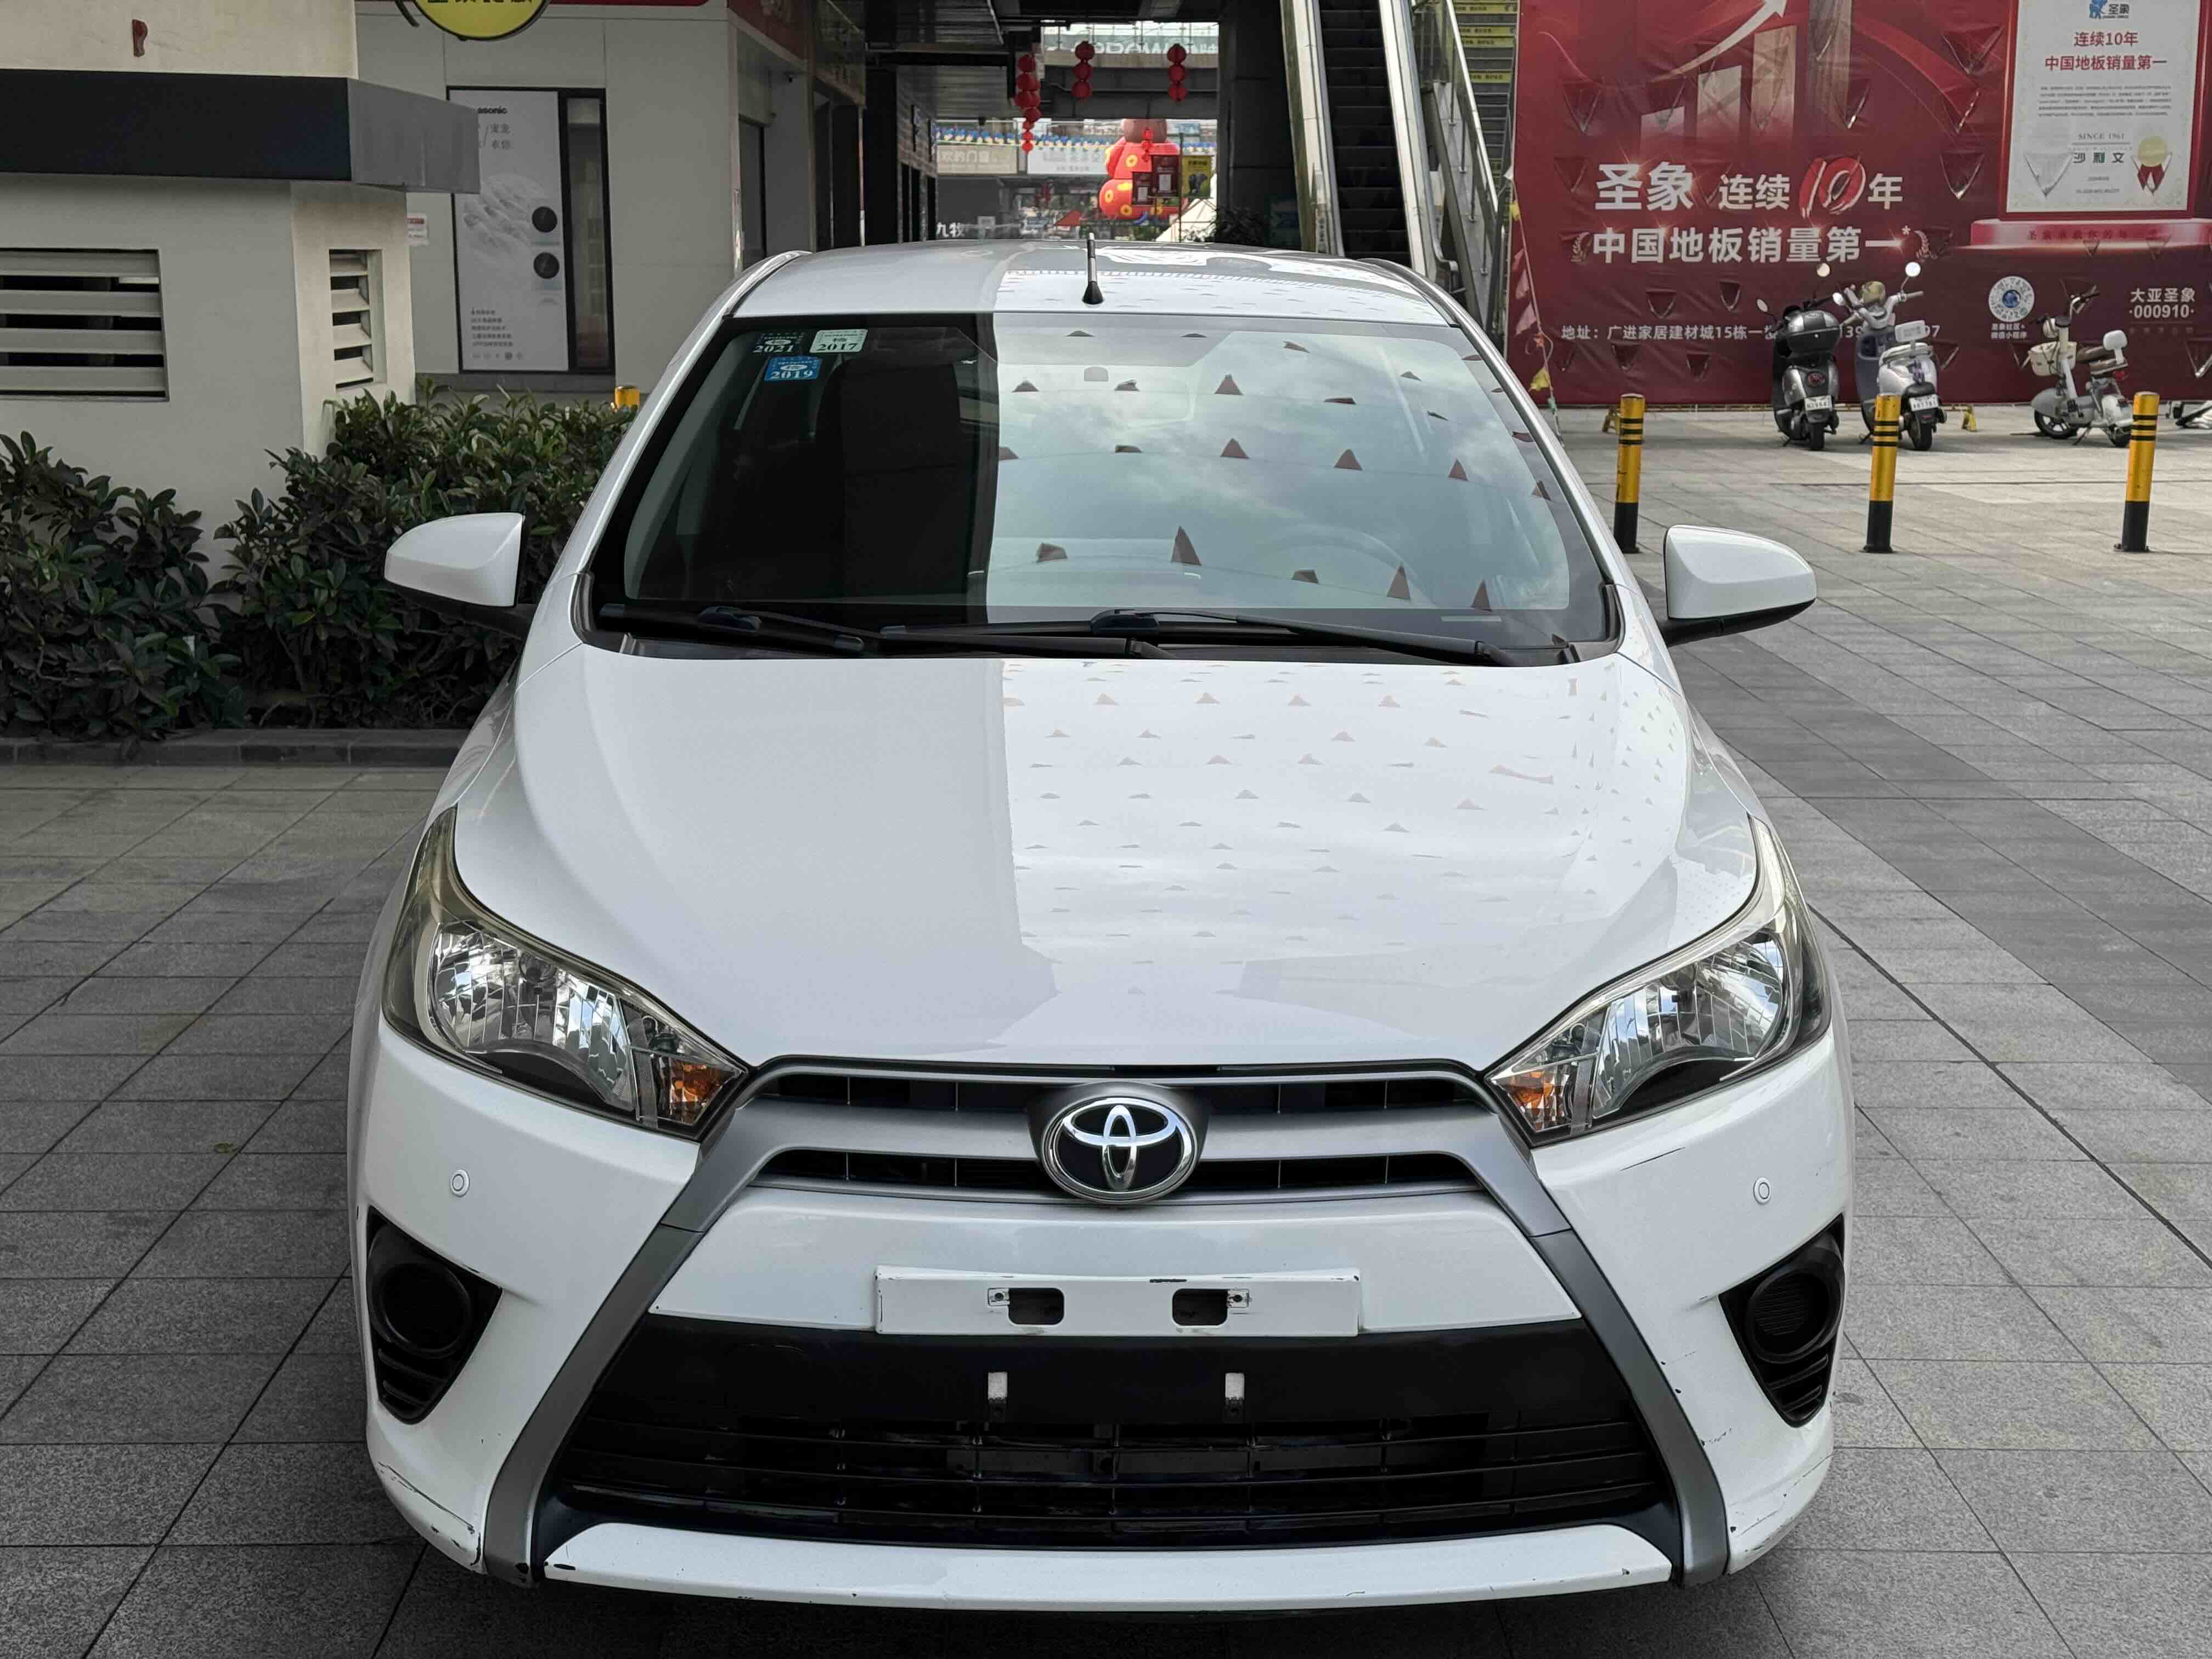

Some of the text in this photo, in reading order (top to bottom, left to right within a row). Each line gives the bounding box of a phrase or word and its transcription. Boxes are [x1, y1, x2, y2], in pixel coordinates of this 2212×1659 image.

[2074, 31, 2138, 47] 连续10年
[2045, 54, 2168, 71] 中国地板销量第一
[478, 106, 508, 114] asonic
[1595, 157, 1903, 219] 圣象 连续10年
[2130, 287, 2195, 303] 大亚圣象
[771, 370, 814, 379] 2019
